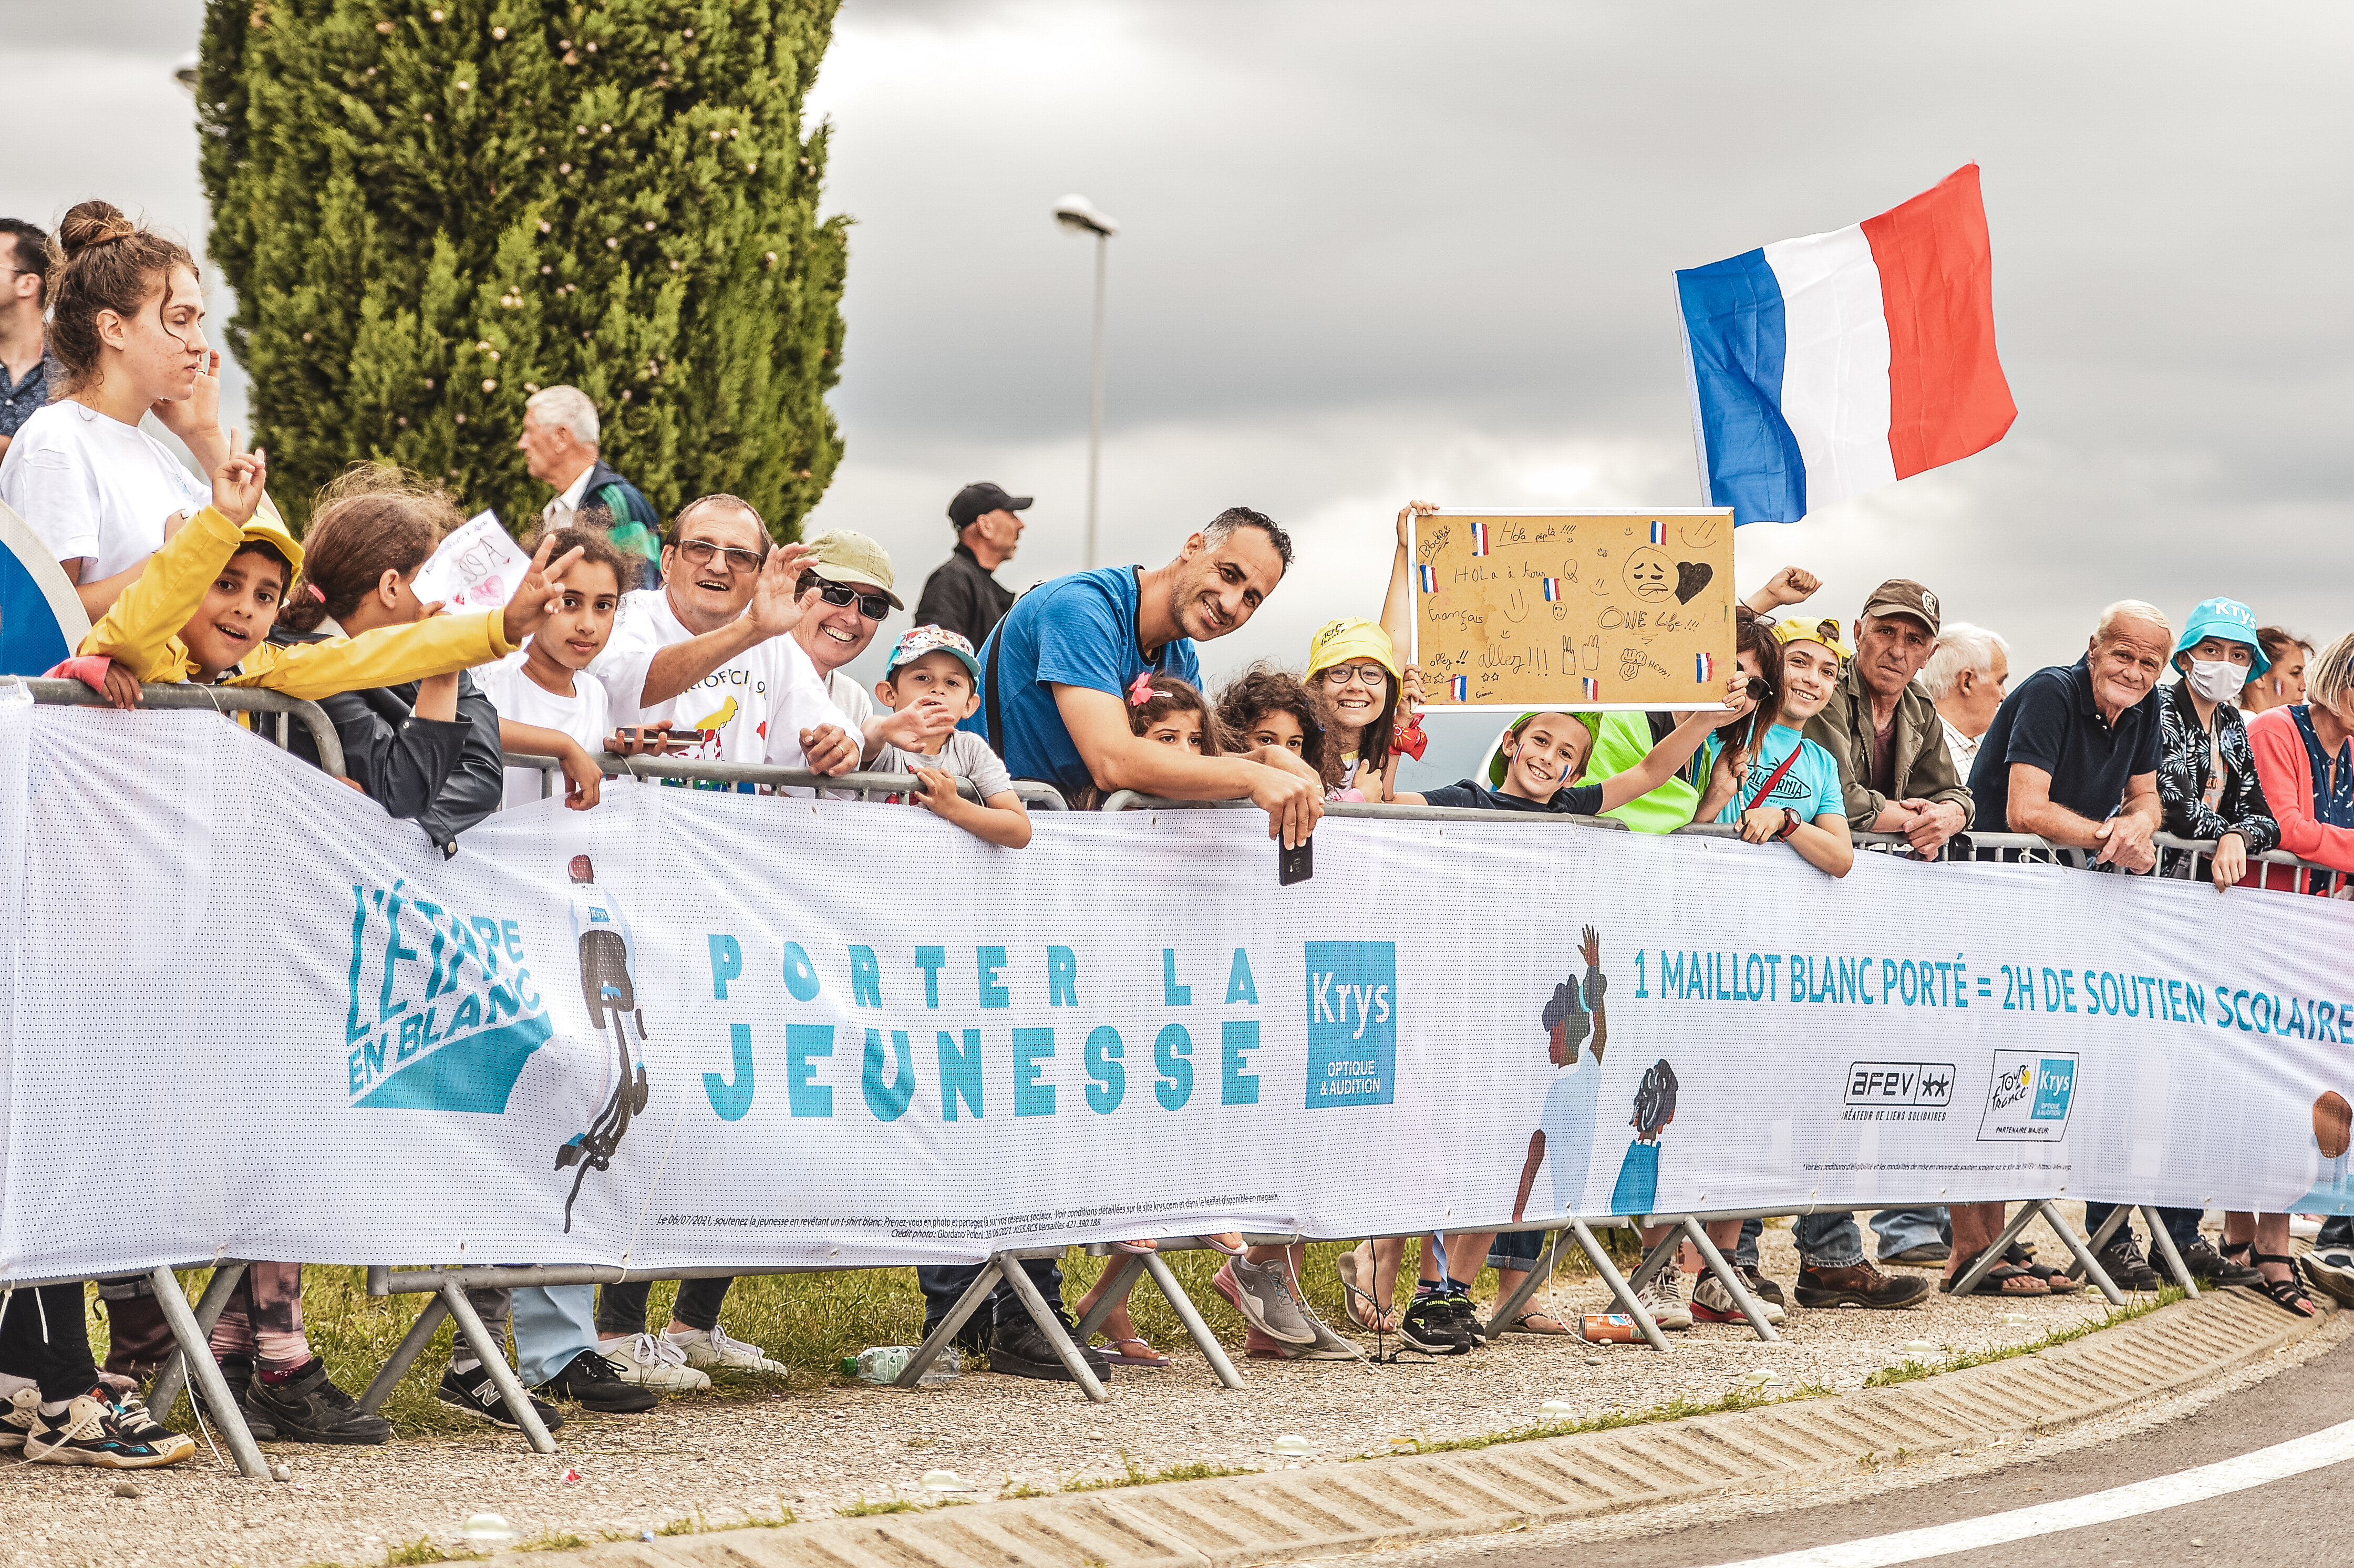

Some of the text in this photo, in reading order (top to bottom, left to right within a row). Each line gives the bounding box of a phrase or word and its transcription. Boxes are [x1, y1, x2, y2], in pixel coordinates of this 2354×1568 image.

[1499, 521, 1526, 542] Hola
[1508, 565, 1515, 579] à
[1597, 605, 1648, 630] ONE
[2215, 601, 2256, 630] Krys
[707, 934, 1259, 1009] PORTER LA
[1313, 972, 1390, 1040] Krys
[1634, 948, 2354, 1044] 1 MAILLOT BLANC PORTÉ = 2H DE SOUTIEN SCOLAIRE
[349, 967, 541, 1096] EN BLANC
[702, 1020, 1259, 1123] JEUNESSE
[1327, 1060, 1376, 1077] OPTIQUE
[1319, 1078, 1381, 1096] & AUDITION
[2039, 1070, 2071, 1097] Krys
[1875, 1110, 1885, 1120] DE
[1886, 1110, 1906, 1121] LIENS
[1907, 1111, 1946, 1121] SOLIDAIRES
[657, 1213, 668, 1225] Le
[715, 1215, 749, 1227] soutenez
[749, 1215, 756, 1227] la
[755, 1216, 789, 1228] jeunesse
[790, 1218, 799, 1226] en
[800, 1216, 830, 1226] revêtant
[830, 1218, 840, 1226] un
[841, 1216, 862, 1226] t-shirt
[884, 1216, 923, 1227] Prenez-vous
[933, 1216, 951, 1229] photo
[952, 1218, 958, 1226] et
[959, 1218, 983, 1229] partagez
[989, 1216, 998, 1226] sur
[998, 1215, 1007, 1225] vos
[1007, 1213, 1029, 1224] réseaux
[1055, 1208, 1067, 1219] Voir
[1067, 1206, 1097, 1218] conditions
[1098, 1203, 1126, 1215] détaillées
[1127, 1205, 1135, 1214] sur
[1137, 1201, 1142, 1212] le
[1143, 1201, 1153, 1212] site
[1153, 1200, 1179, 1212] krys.com
[1179, 1198, 1185, 1209] et
[1185, 1198, 1199, 1208] dans
[1199, 1196, 1204, 1207] le
[1204, 1195, 1221, 1206] leaflet
[1222, 1193, 1248, 1205] disponible
[891, 1228, 912, 1238] Crédit
[937, 1229, 965, 1239] Giordano
[1038, 1221, 1065, 1232] Versailles
[1066, 1220, 1076, 1229] 421
[1077, 1219, 1089, 1228] 390
[471, 1378, 501, 1407] N
